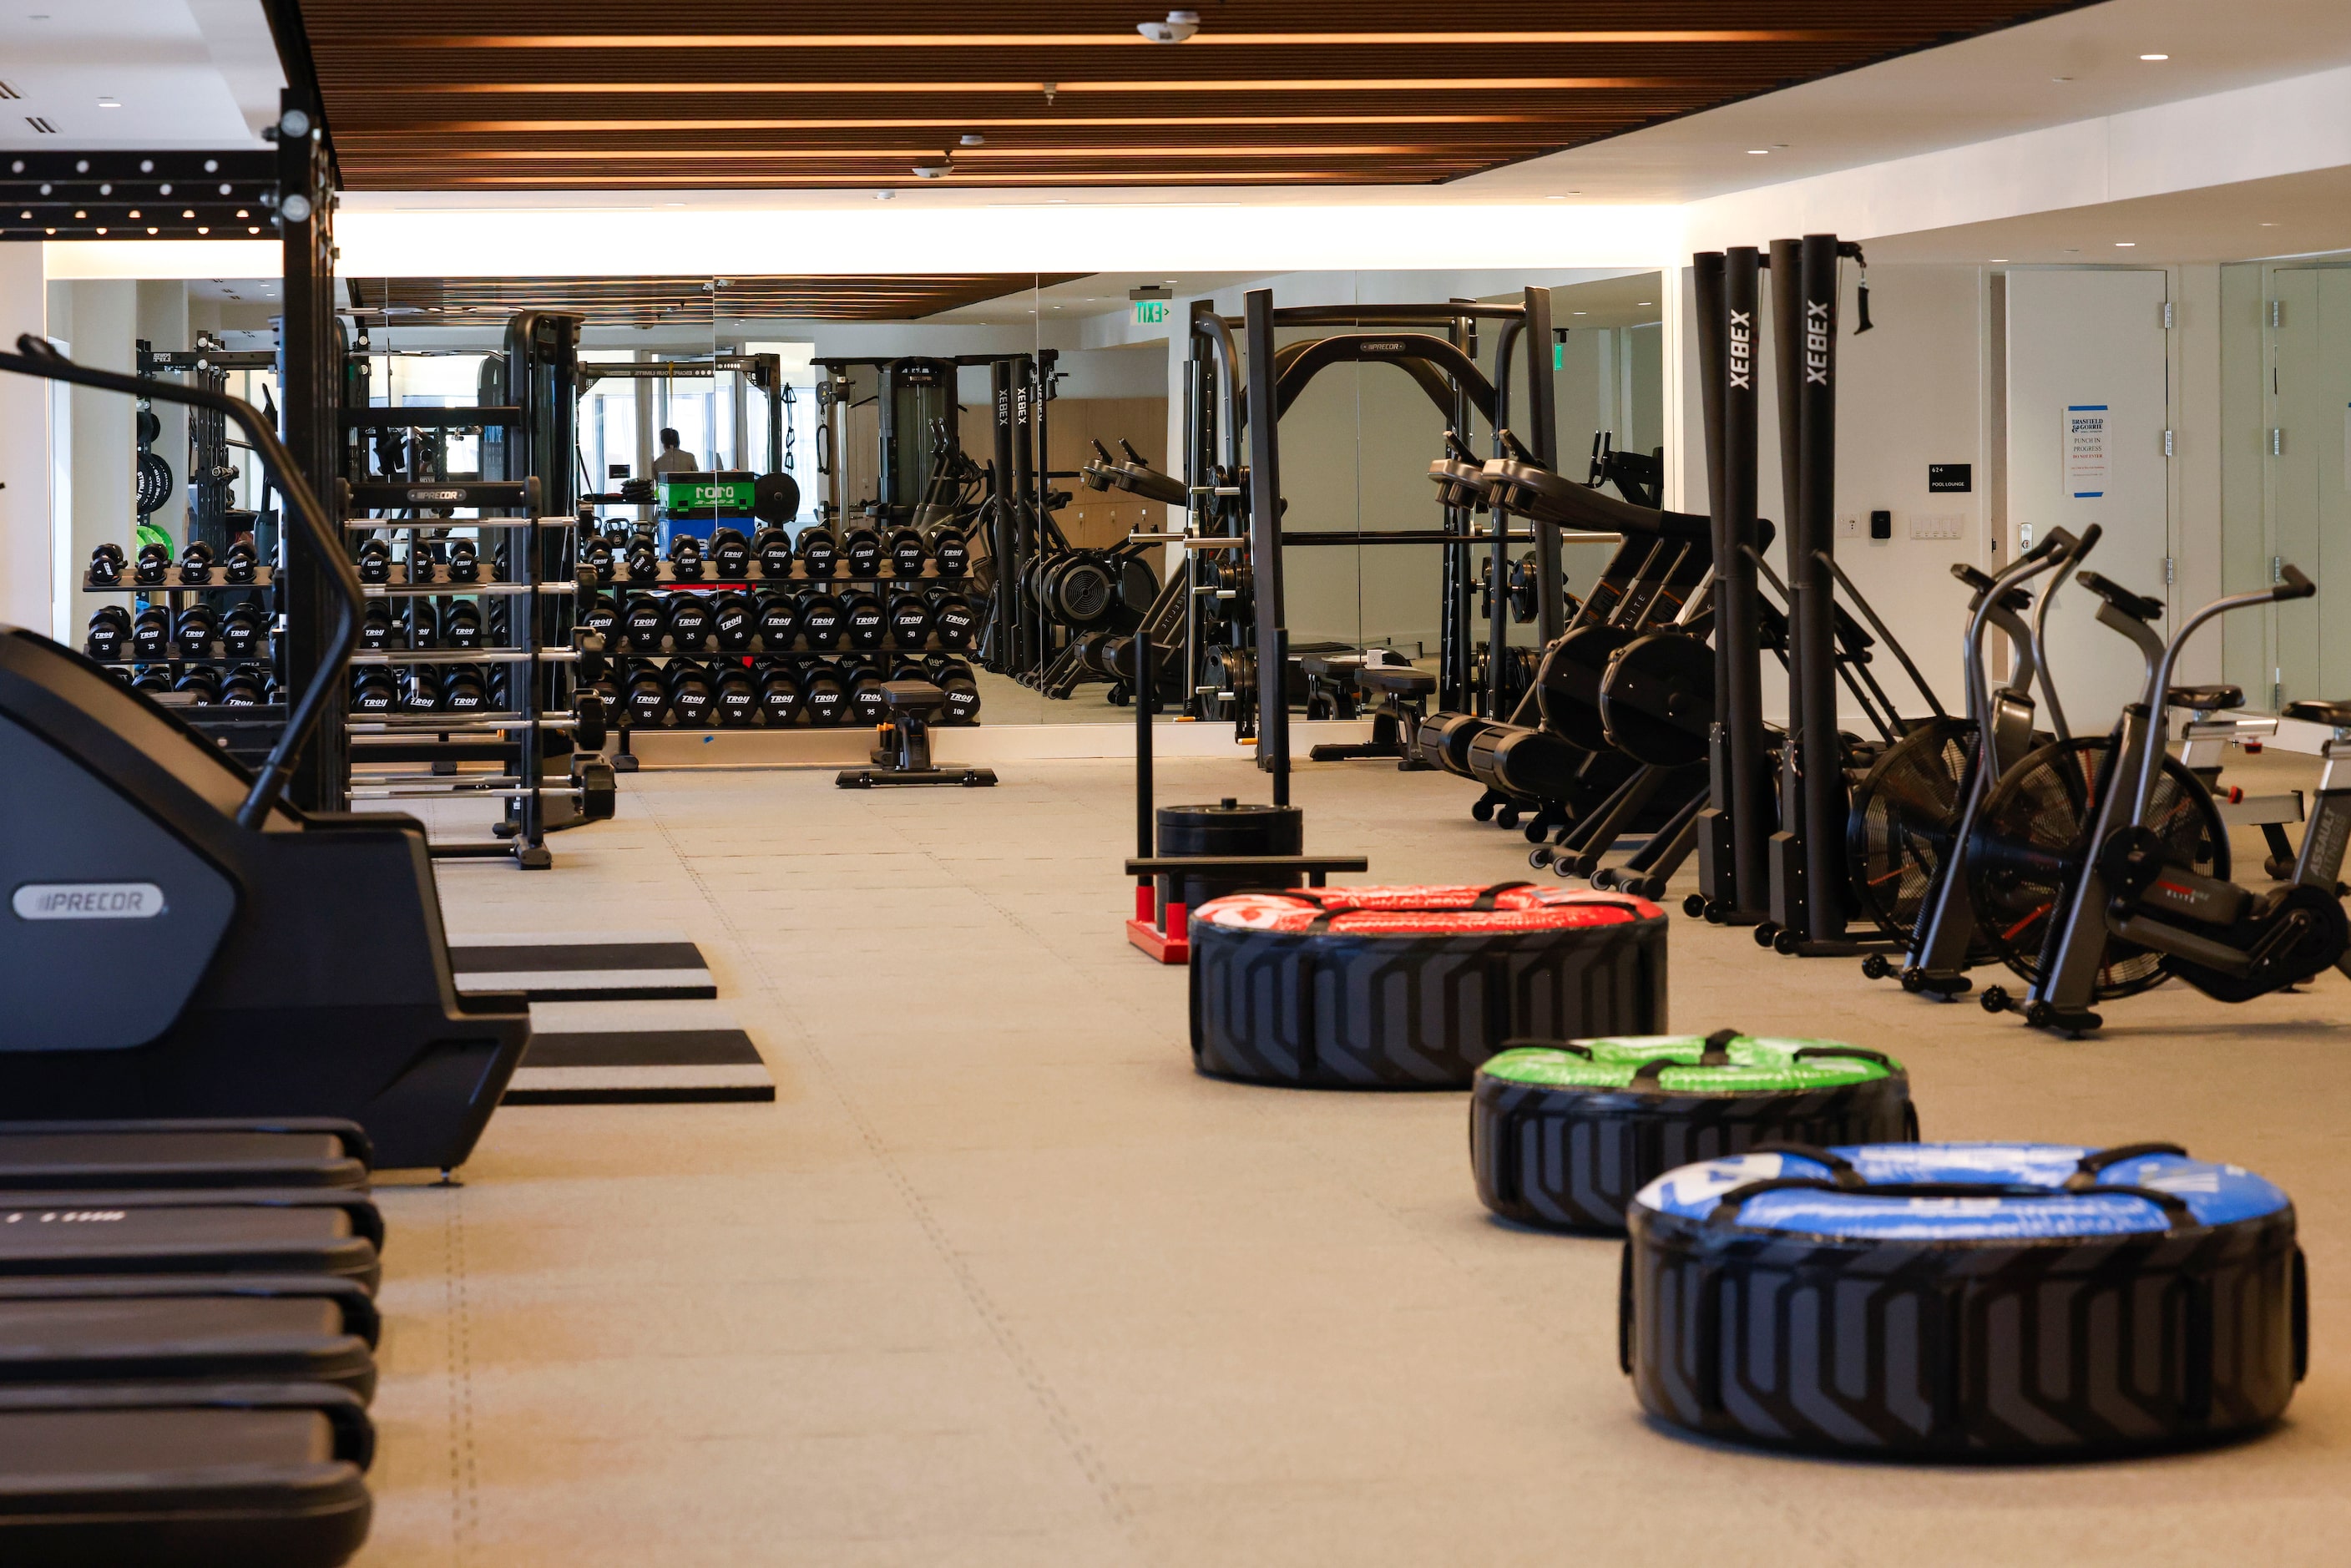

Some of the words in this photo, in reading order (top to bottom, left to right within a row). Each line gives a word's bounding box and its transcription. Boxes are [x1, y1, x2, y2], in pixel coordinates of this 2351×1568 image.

[1807, 299, 1828, 387] XEBEX
[1730, 308, 1751, 391] XEBEX
[422, 491, 458, 499] PRECOR
[855, 549, 874, 558] TROY
[142, 561, 158, 569] TROY
[232, 560, 248, 569] TROY
[633, 556, 645, 570] TROY
[103, 562, 114, 576] TROY
[589, 618, 613, 627] TROY
[633, 618, 658, 627] TROY
[678, 617, 702, 626] TROY
[720, 615, 742, 630] TROY
[767, 617, 791, 626] TROY
[811, 617, 835, 626] TROY
[856, 615, 879, 625] TROY
[899, 615, 923, 625] TROY
[946, 614, 970, 625] TROY
[95, 631, 114, 640] TROY
[139, 630, 159, 640] TROY
[230, 629, 250, 637] TROY
[735, 631, 743, 640] 40
[453, 697, 478, 706] TROY
[636, 695, 661, 705] TROY
[681, 695, 706, 705] TROY
[726, 695, 751, 705] TROY
[770, 695, 794, 704] TROY
[814, 694, 838, 703] TROY
[860, 693, 882, 702] TROY
[949, 692, 974, 703] TROY
[363, 698, 388, 707] TROY
[410, 697, 435, 708] TROY
[2310, 806, 2335, 876] ASSAULT
[51, 892, 144, 912] PRECOR
